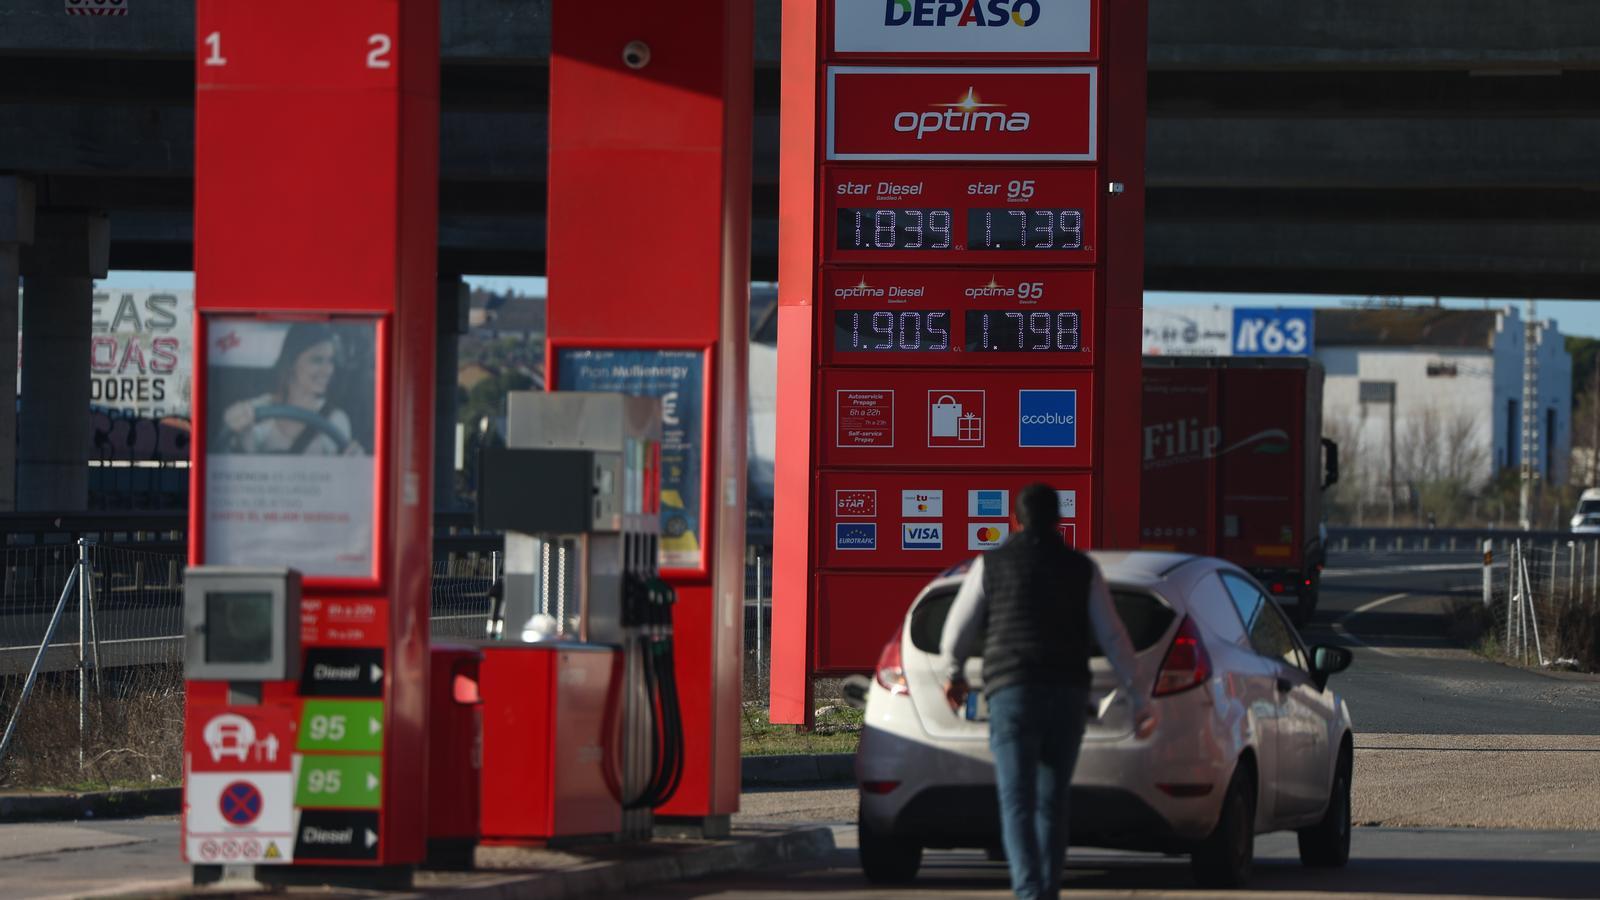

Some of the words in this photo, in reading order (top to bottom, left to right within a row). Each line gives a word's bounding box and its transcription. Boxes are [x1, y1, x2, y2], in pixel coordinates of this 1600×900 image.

[884, 0, 1041, 27] DEPASO
[205, 32, 227, 66] 1
[366, 34, 391, 68] 2
[893, 108, 1031, 140] optima
[836, 182, 871, 195] star
[877, 182, 923, 195] Diesel
[967, 182, 1001, 195] star
[1007, 180, 1035, 198] 95
[855, 210, 951, 248] 1.839
[985, 210, 1081, 248] 1.739
[834, 285, 884, 299] optima
[888, 286, 925, 297] Diesel
[965, 285, 1015, 299] optima
[1017, 282, 1044, 299] 95
[853, 311, 948, 349] 1.905
[983, 312, 1078, 349] 1.798
[866, 408, 881, 416] 22h
[1021, 412, 1074, 425] ecoblue
[838, 499, 865, 508] STAR
[907, 528, 940, 540] VISA
[313, 664, 361, 680] Diesel
[309, 715, 346, 741] 95
[307, 769, 342, 794] 95
[303, 826, 353, 843] Diesel
